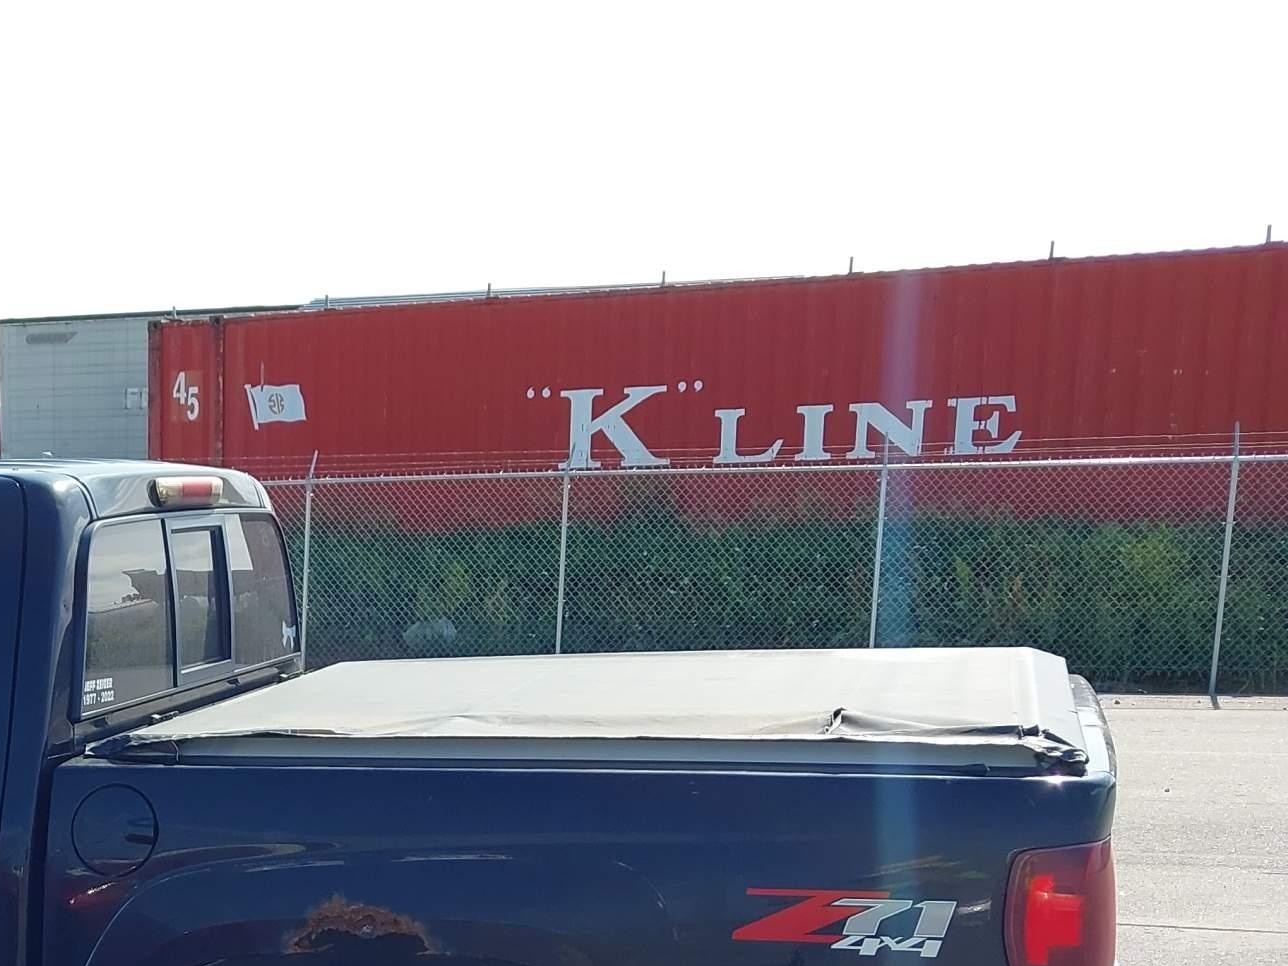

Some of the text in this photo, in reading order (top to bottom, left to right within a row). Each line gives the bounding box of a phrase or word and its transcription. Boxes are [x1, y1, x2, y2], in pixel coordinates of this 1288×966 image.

[172, 371, 200, 420] 45
[713, 395, 1022, 465] LINE
[732, 887, 958, 943] Z71
